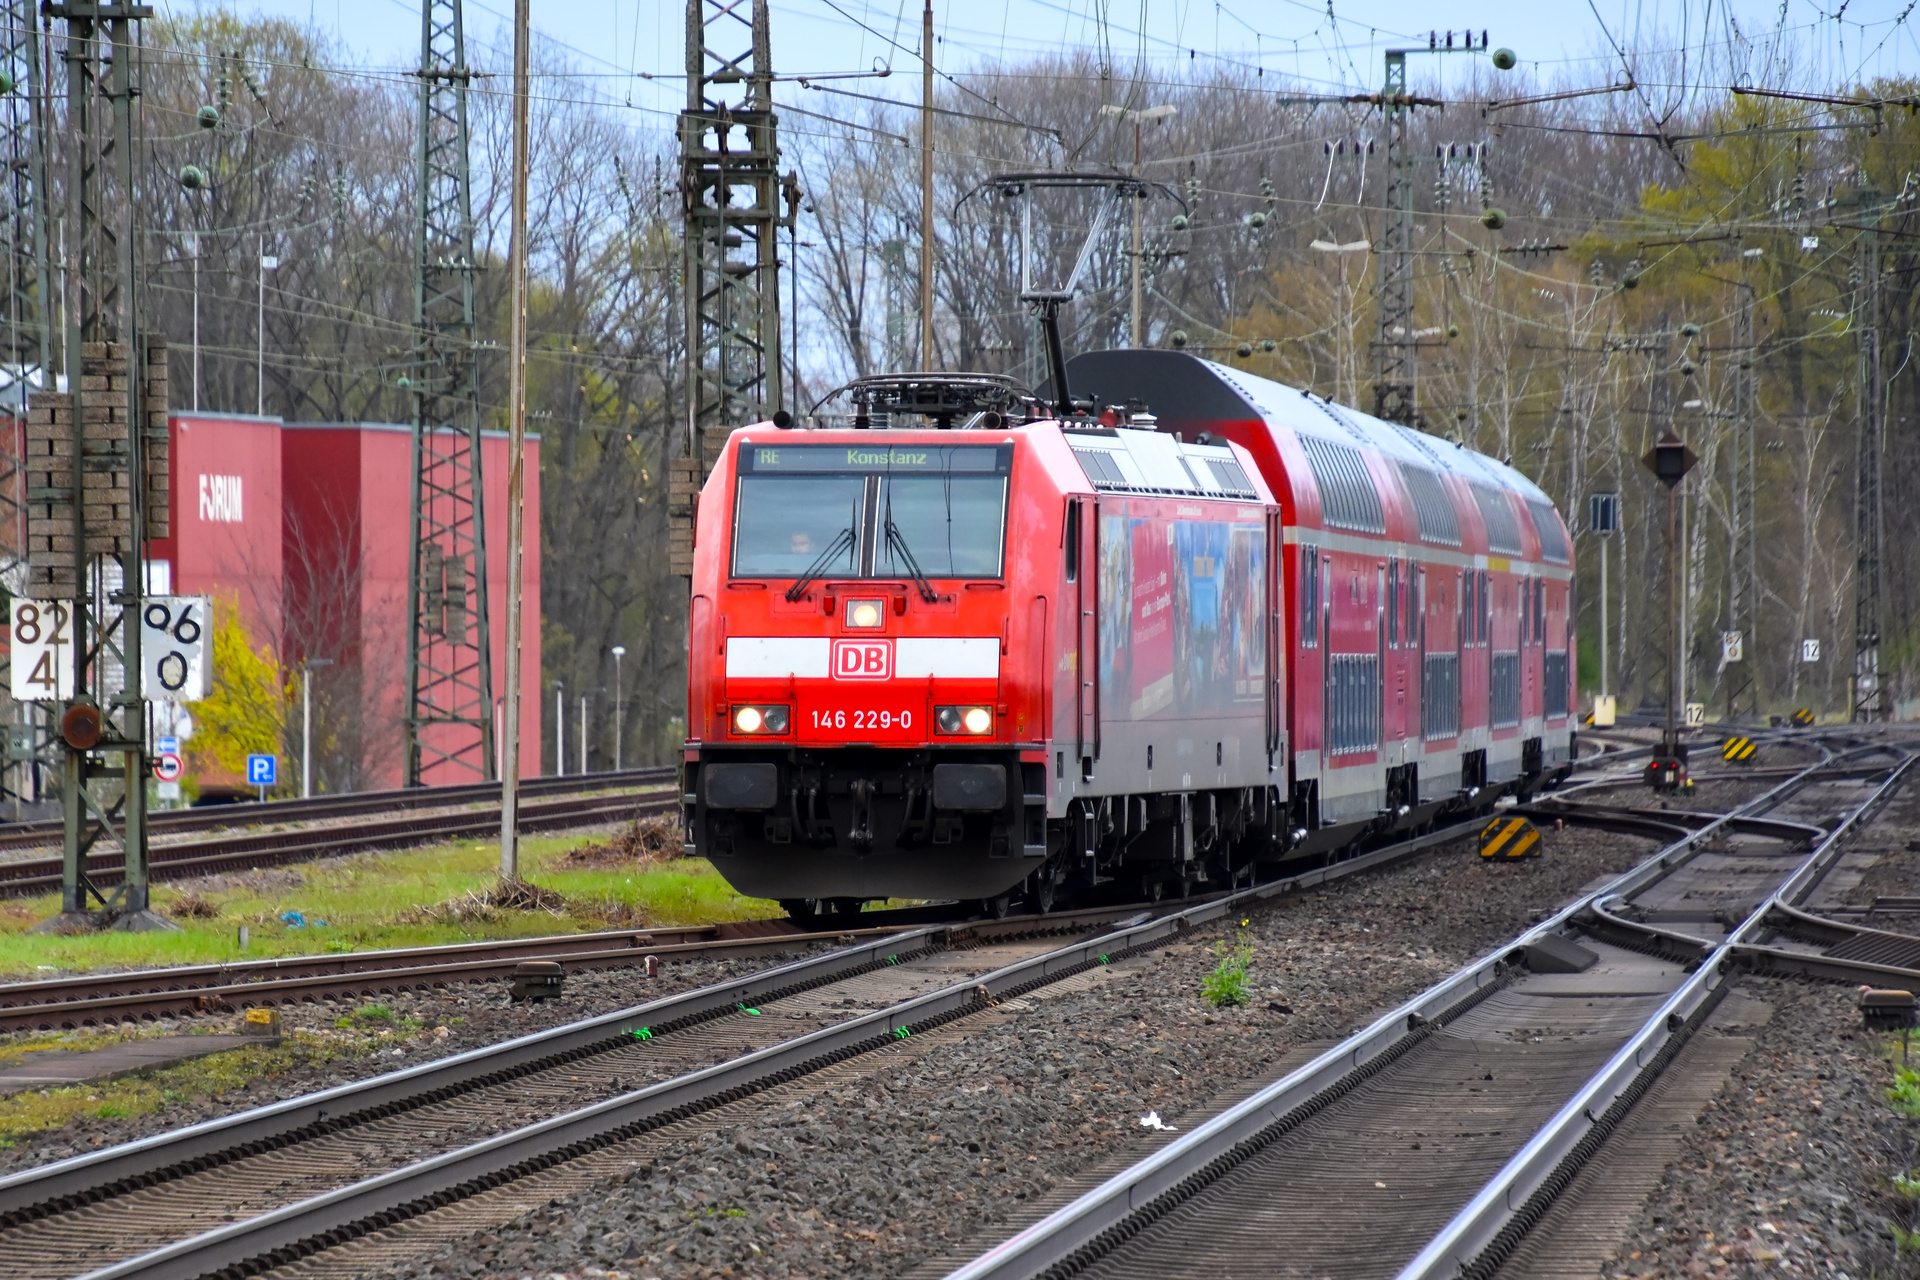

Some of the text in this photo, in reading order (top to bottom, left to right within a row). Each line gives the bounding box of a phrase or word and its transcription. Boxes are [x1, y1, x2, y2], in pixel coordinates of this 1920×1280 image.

[760, 450, 927, 465] RE Konstanz
[199, 473, 243, 522] FORUM
[15, 604, 69, 644] 82
[143, 603, 201, 644] 96
[841, 647, 884, 673] DB
[1804, 642, 1819, 658] 12
[27, 650, 56, 691] 4
[157, 650, 188, 690] 0
[811, 710, 912, 729] 146 229-0
[1687, 707, 1703, 723] 12
[254, 759, 270, 781] P
